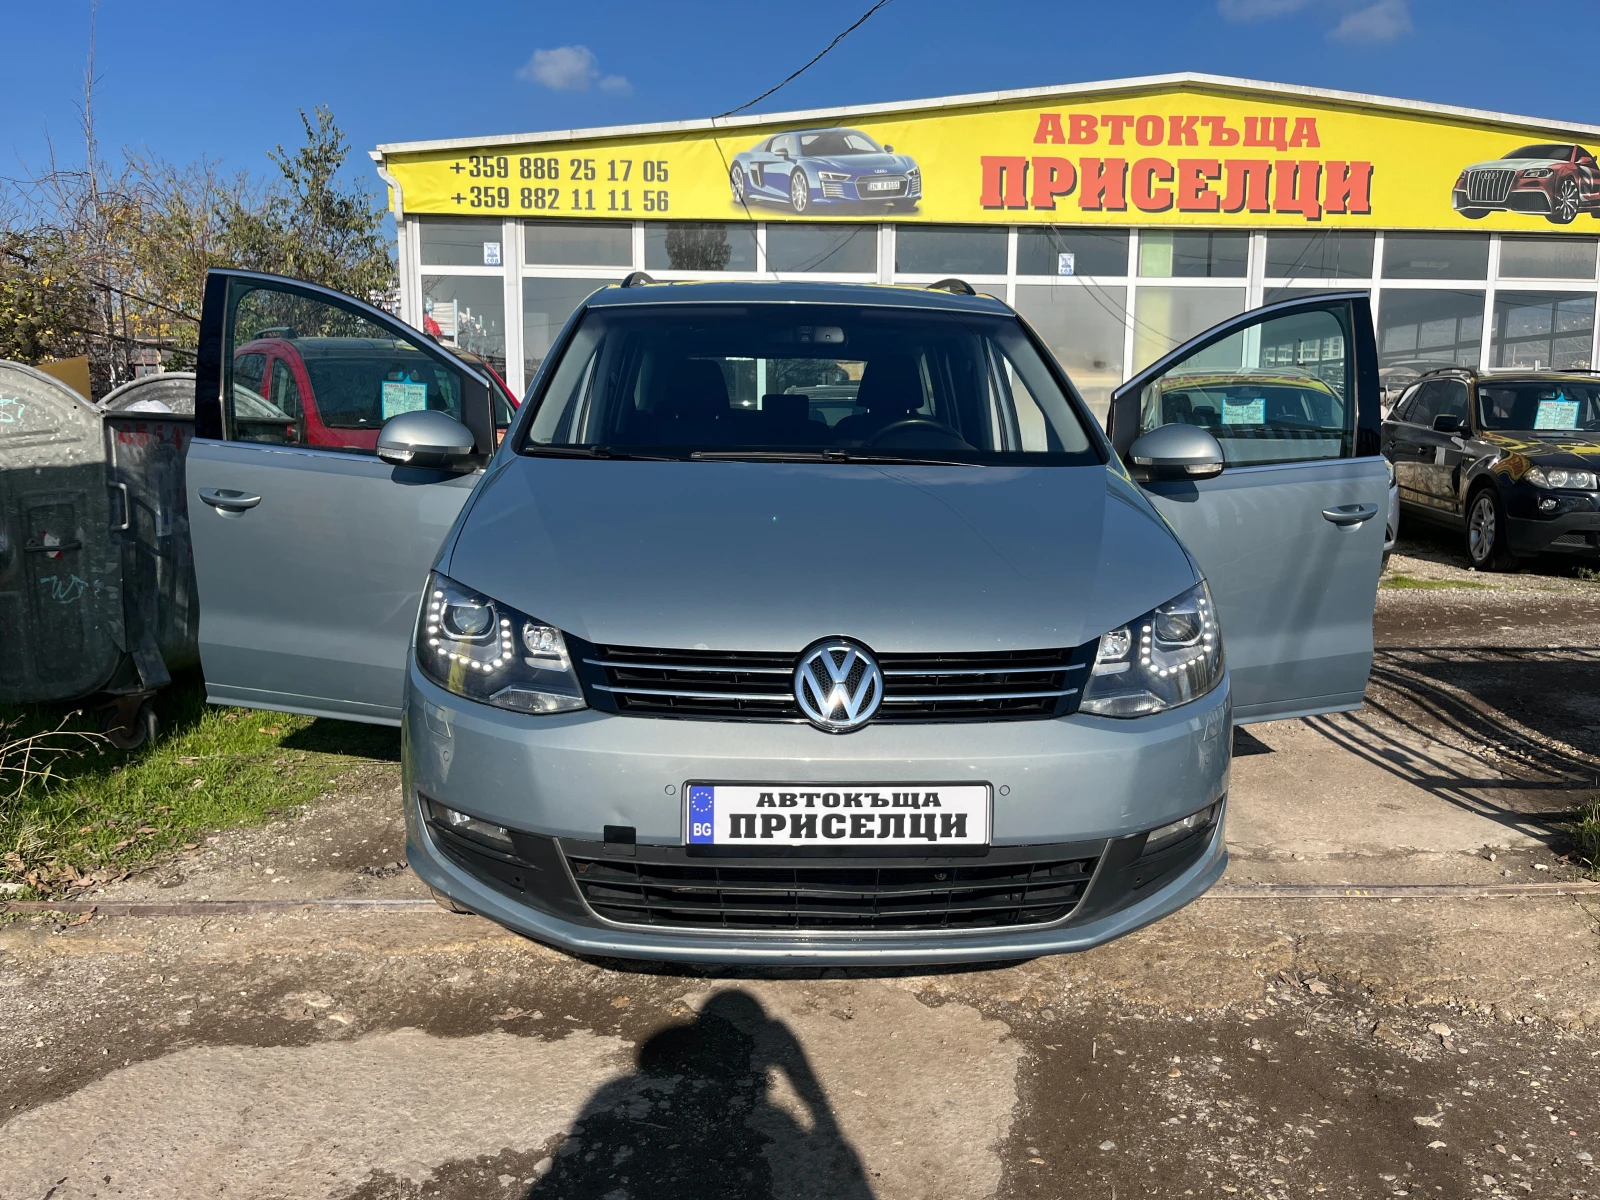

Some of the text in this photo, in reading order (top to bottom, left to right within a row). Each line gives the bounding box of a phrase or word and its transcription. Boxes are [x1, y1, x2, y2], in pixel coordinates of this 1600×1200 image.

[1033, 113, 1321, 152] АВТОКЪЩА
[449, 155, 669, 183] +359 886 25 17 05
[450, 186, 669, 212] +359 882 11 11 56
[979, 155, 1374, 221] ПРИСЕЛЦИ
[797, 643, 880, 725] VW
[755, 792, 942, 810] АВТОКЪЩА
[693, 822, 712, 837] BG
[728, 813, 968, 841] ПРИСЕЛЦИ
